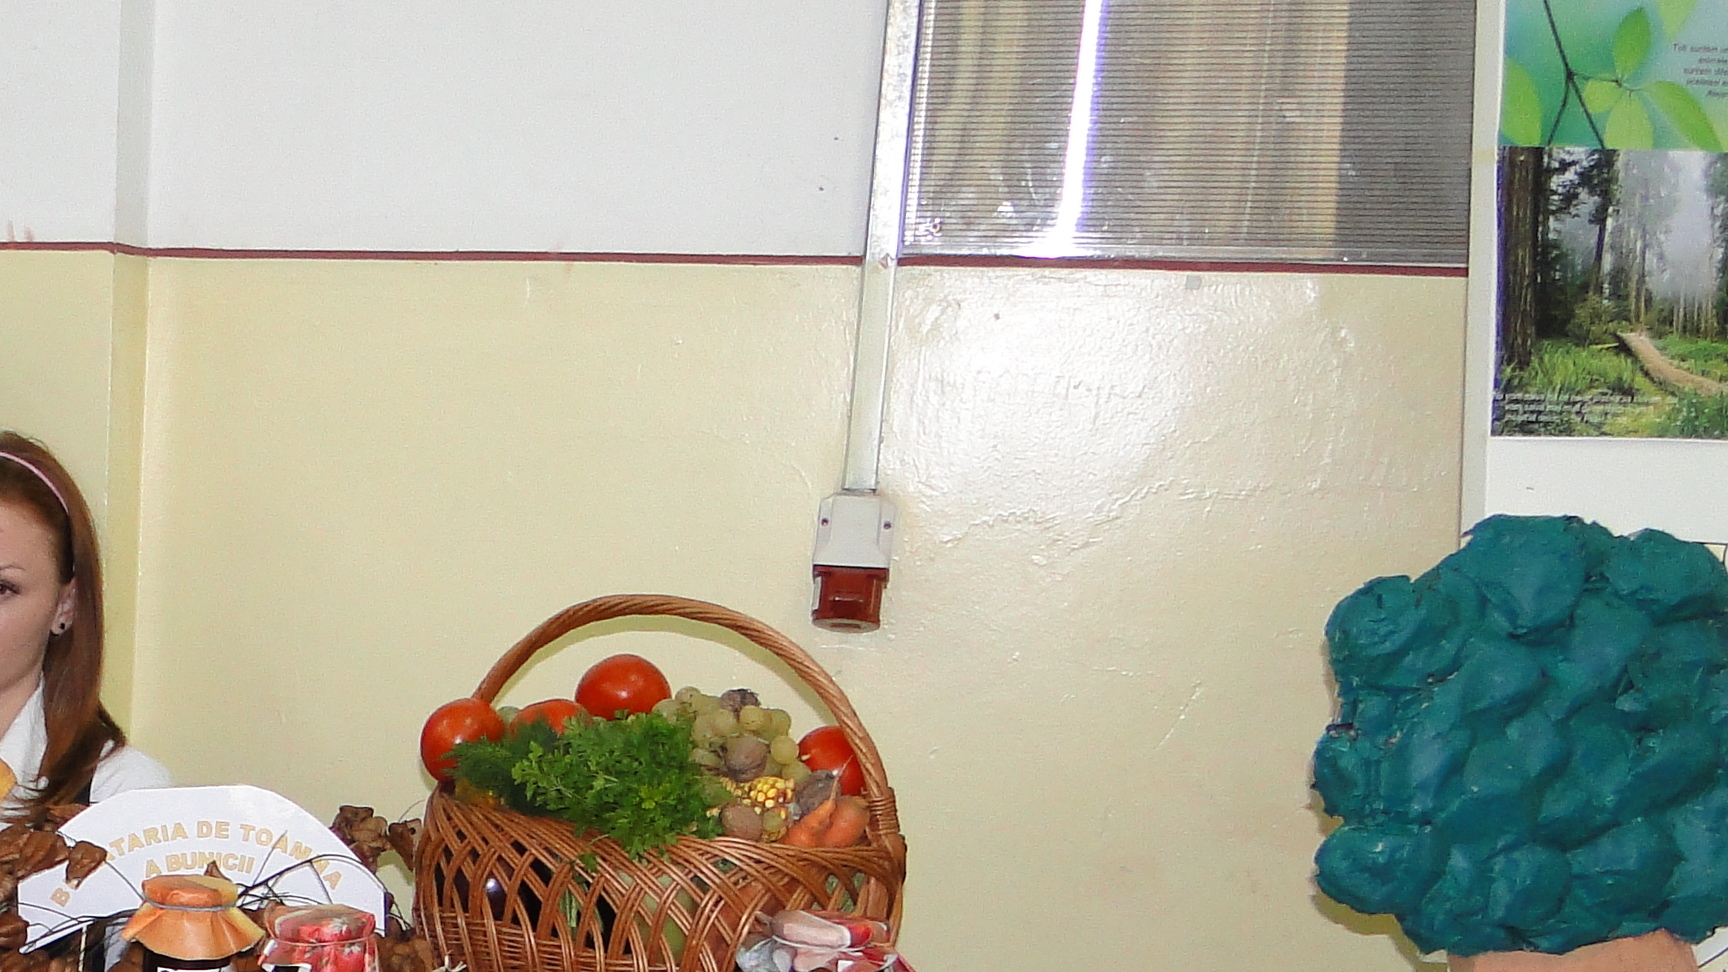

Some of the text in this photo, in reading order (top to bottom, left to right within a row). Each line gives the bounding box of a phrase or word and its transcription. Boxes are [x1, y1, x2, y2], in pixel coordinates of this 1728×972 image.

[197, 820, 230, 839] DE
[146, 851, 256, 878] A BUNICII
